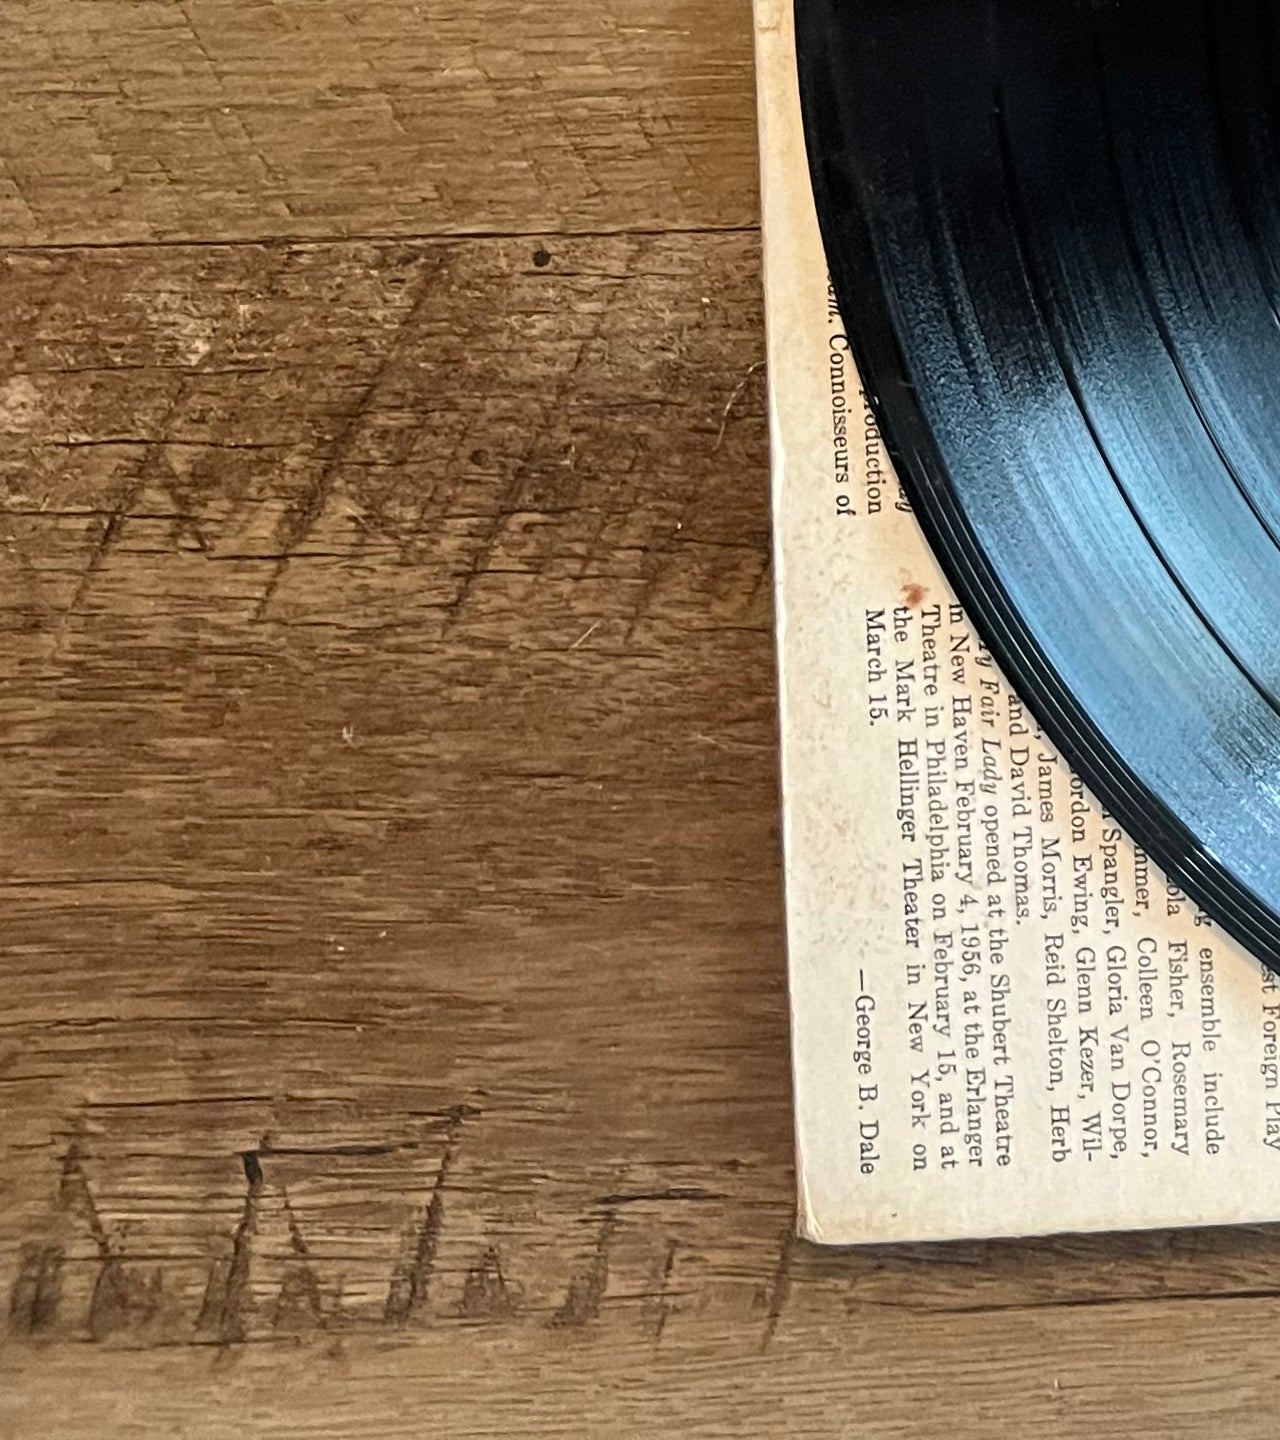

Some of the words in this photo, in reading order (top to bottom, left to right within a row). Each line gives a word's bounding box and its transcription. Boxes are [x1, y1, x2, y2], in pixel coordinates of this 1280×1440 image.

[829, 335, 852, 483] Connoisseurs
[836, 495, 856, 516] of
[866, 609, 887, 683] March
[893, 607, 913, 642] the
[921, 605, 941, 695] Theatre
[870, 695, 888, 726] 15.
[896, 660, 915, 722] Mark
[924, 707, 944, 727] in
[897, 739, 920, 842] Hellinger
[926, 739, 950, 882] Philadelphia
[903, 858, 923, 948] Theater
[932, 894, 947, 920] on
[907, 964, 926, 985] in
[933, 932, 954, 1037] February
[908, 1002, 927, 1052] New
[936, 1051, 957, 1082] 15,
[858, 1084, 878, 1110] B.
[910, 1070, 930, 1127] York
[939, 1093, 959, 1134] and
[859, 1121, 880, 1174] Dale
[913, 1144, 929, 1171] on
[941, 1146, 959, 1169] at
